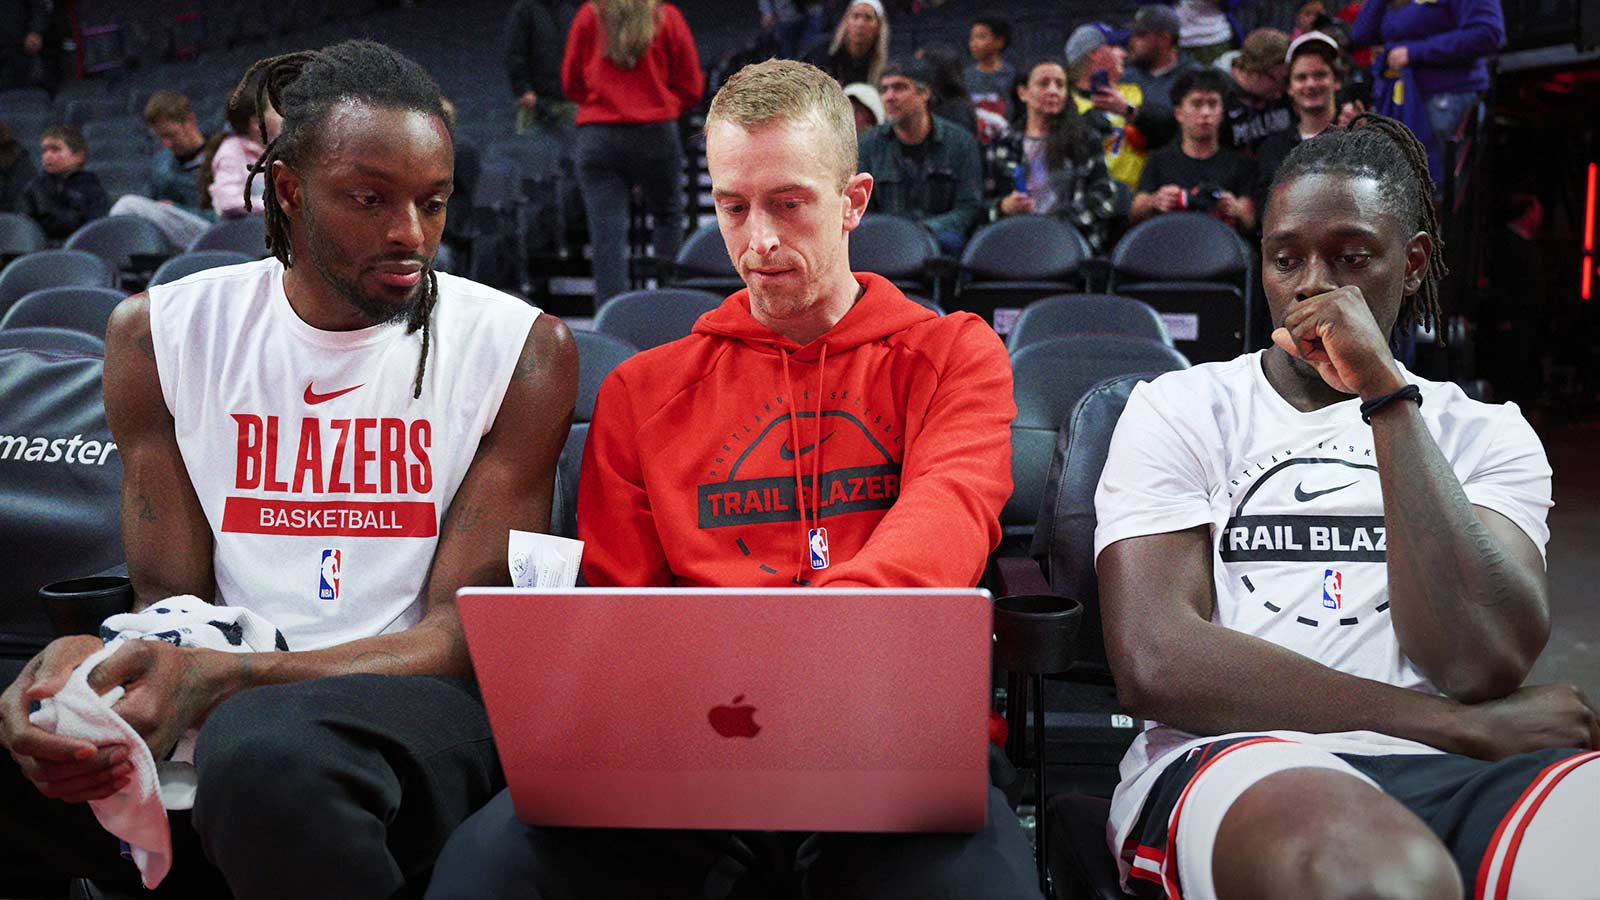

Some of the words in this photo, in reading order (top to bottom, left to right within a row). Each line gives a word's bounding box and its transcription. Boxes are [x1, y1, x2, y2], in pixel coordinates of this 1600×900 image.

[0, 434, 118, 465] master
[230, 413, 433, 494] BLAZERS
[707, 487, 788, 517] TRAIL
[259, 508, 402, 529] BASKETBALL
[1224, 526, 1302, 551] RAIL
[320, 588, 333, 598] NBA
[1115, 715, 1129, 726] 12
